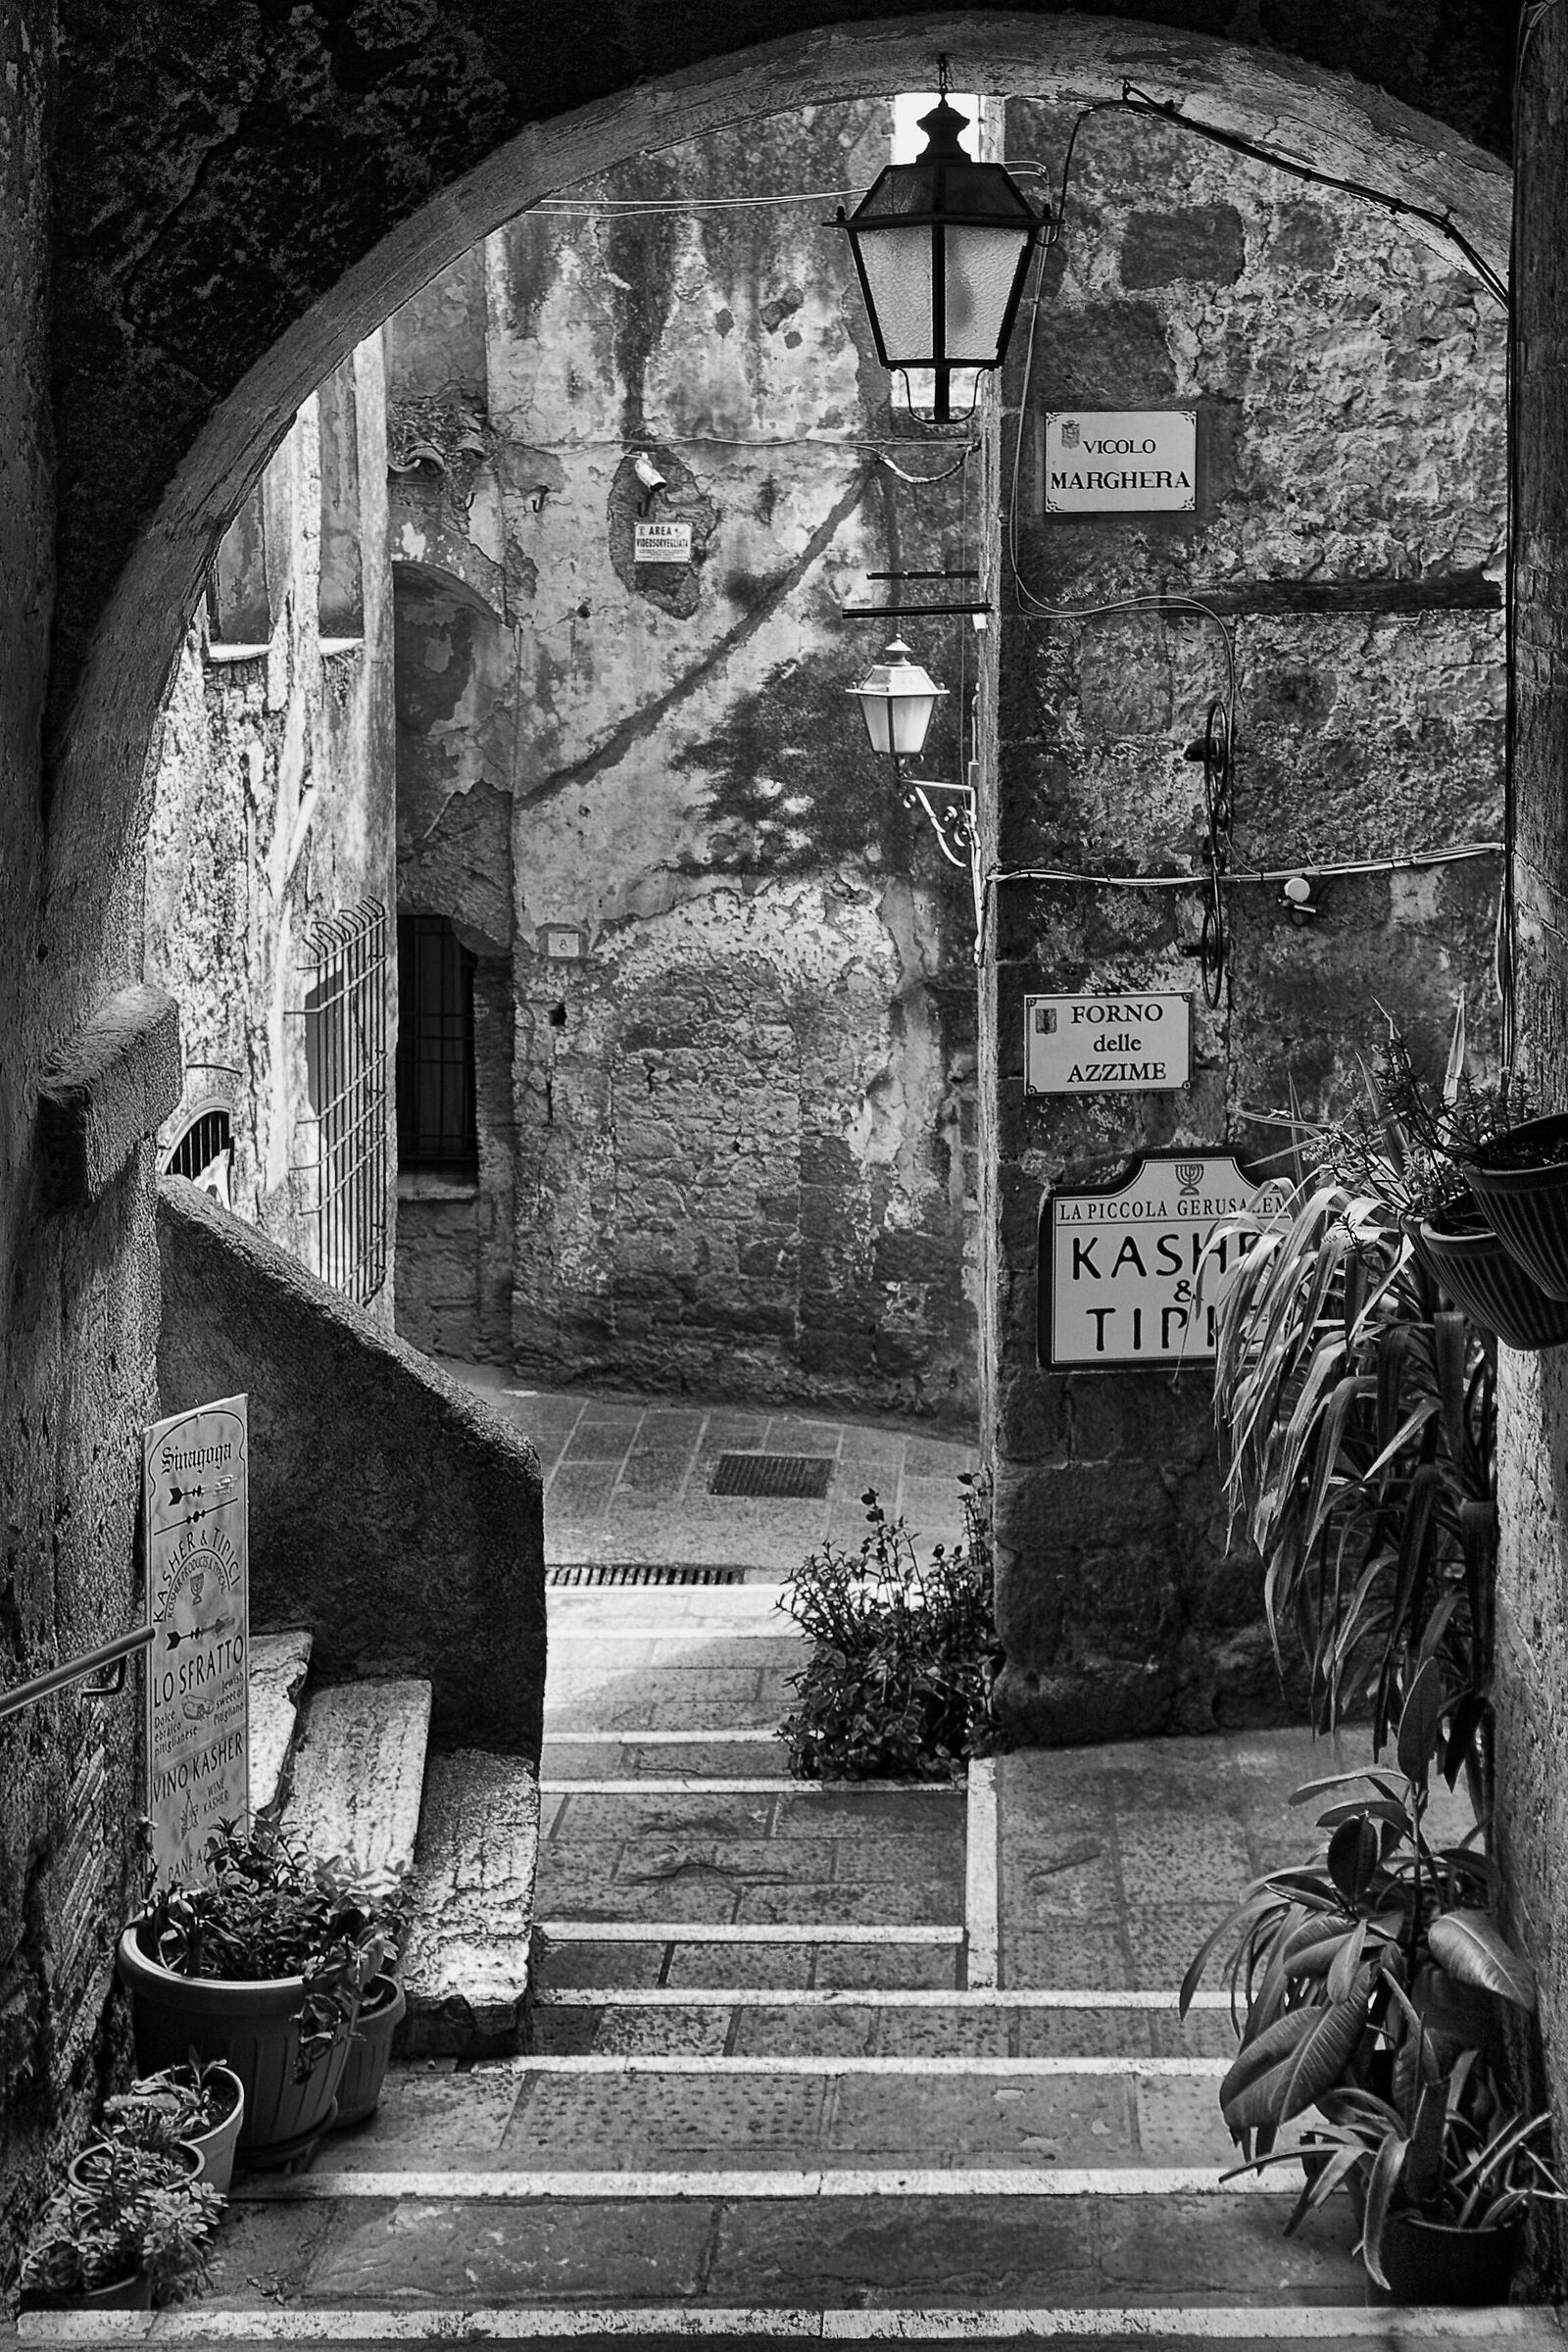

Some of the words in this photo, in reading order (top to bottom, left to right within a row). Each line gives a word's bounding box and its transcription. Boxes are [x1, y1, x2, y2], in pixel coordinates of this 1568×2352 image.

[1083, 439, 1156, 454] VICOLO
[1051, 471, 1191, 489] MARGHERA
[649, 526, 672, 536] AREA
[1071, 1004, 1163, 1024] FORNO
[1093, 1034, 1142, 1053] delle
[1066, 1062, 1167, 1083] AZZIME
[1060, 1204, 1082, 1221] LA
[1088, 1201, 1168, 1219] PICCOLA
[1173, 1280, 1203, 1302] &
[161, 1443, 231, 1475] Sinagoga
[153, 1532, 196, 1623] KASHER
[200, 1530, 208, 1546] &
[213, 1528, 241, 1587] TIPICI
[154, 1672, 174, 1708] LO
[179, 1635, 244, 1694] SFRATTO
[155, 1710, 175, 1730] Dolce
[155, 1722, 182, 1743] ebraico
[155, 1726, 198, 1758] pitiglianese
[153, 1764, 188, 1803] VINO
[193, 1732, 243, 1782] KASHER
[208, 1777, 225, 1798] WINE
[203, 1789, 229, 1813] KASHER
[169, 1853, 193, 1884] PANE
